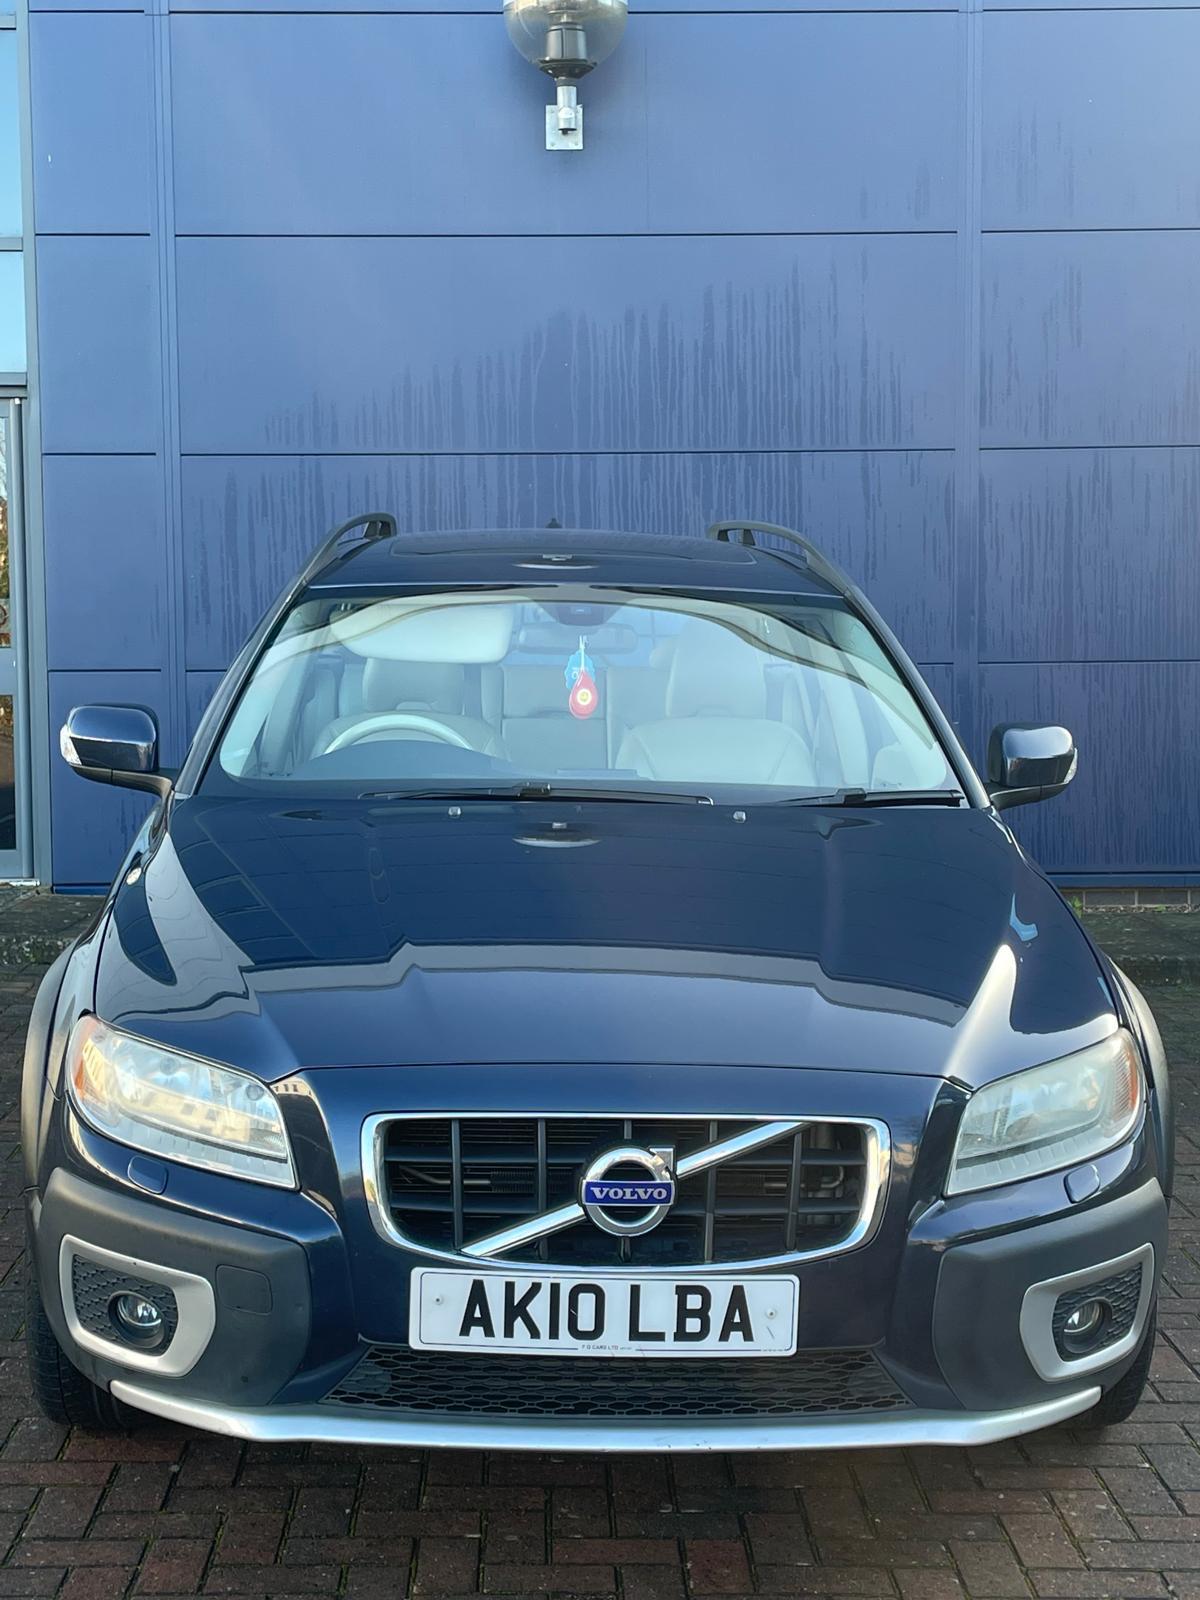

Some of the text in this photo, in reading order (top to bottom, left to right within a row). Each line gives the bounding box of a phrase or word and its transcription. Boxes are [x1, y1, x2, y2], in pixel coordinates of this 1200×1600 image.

[590, 1187, 667, 1200] VOLVO
[459, 1279, 754, 1342] AK10 LBA
